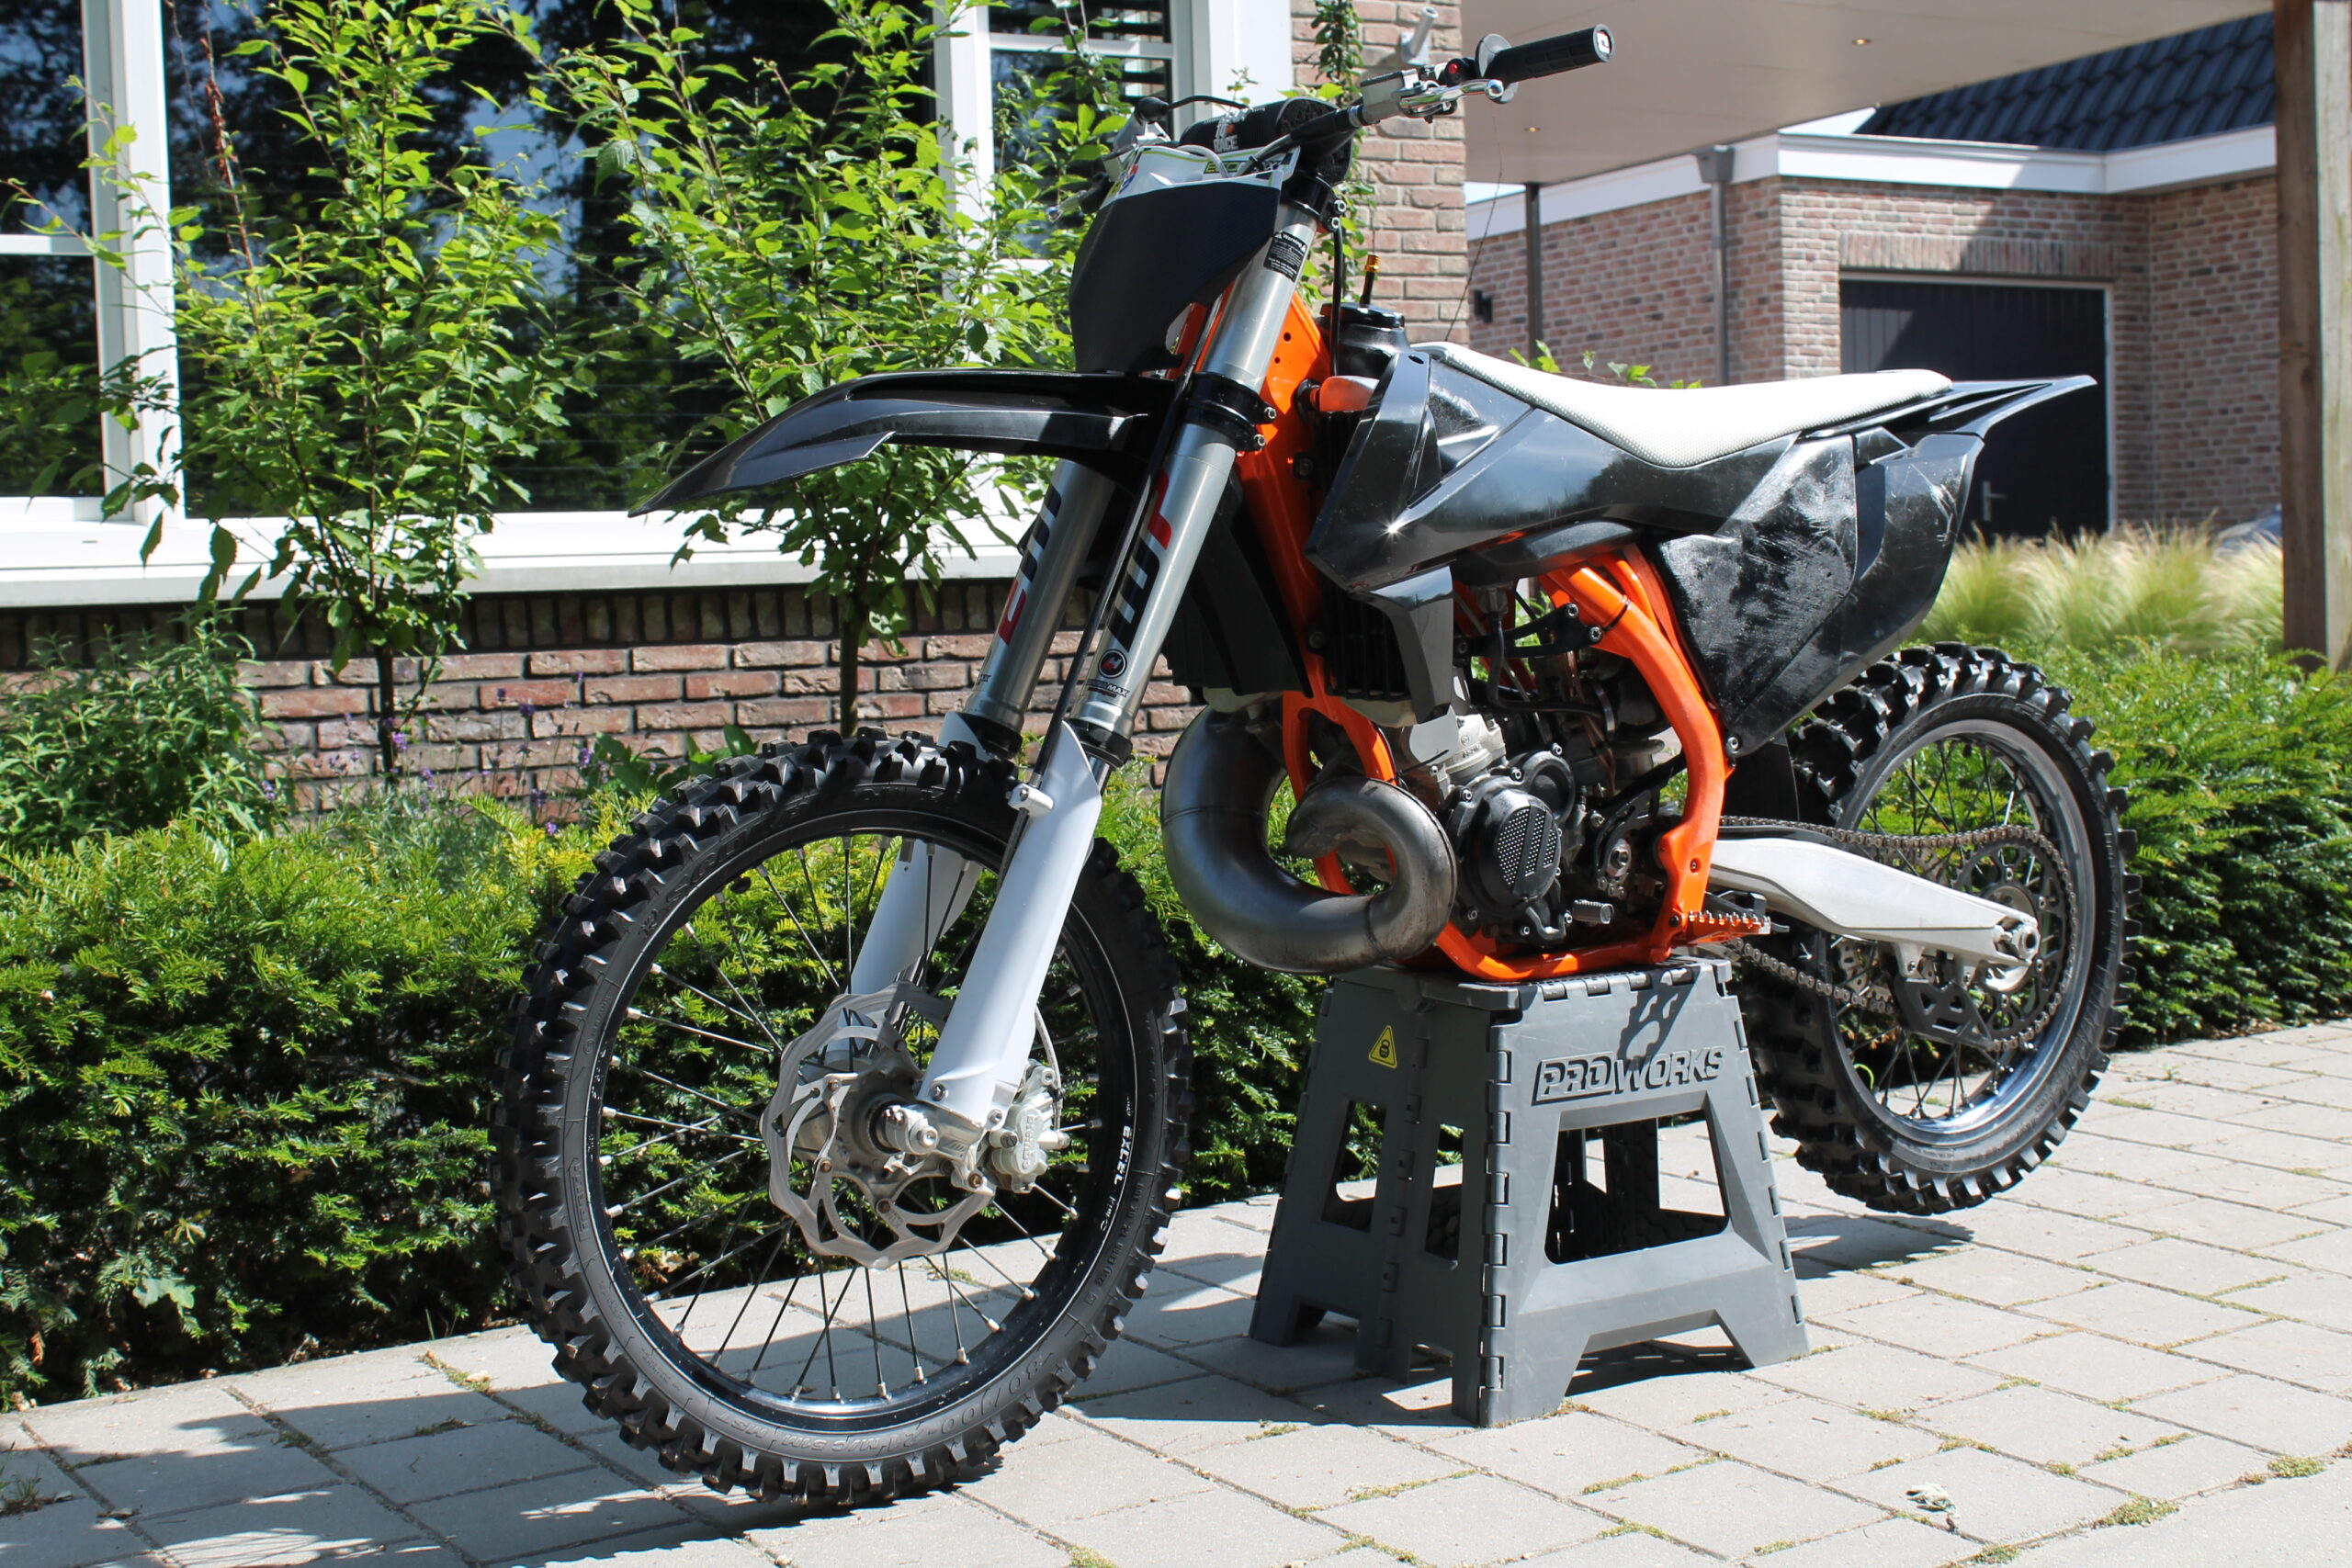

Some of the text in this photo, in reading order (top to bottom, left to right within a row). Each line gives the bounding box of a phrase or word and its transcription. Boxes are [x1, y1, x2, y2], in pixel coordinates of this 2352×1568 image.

[1214, 134, 1239, 153] RACE
[1283, 233, 1303, 248] Warning
[1538, 1046, 1727, 1099] PROWORKS
[1114, 1124, 1133, 1186] EXCEL
